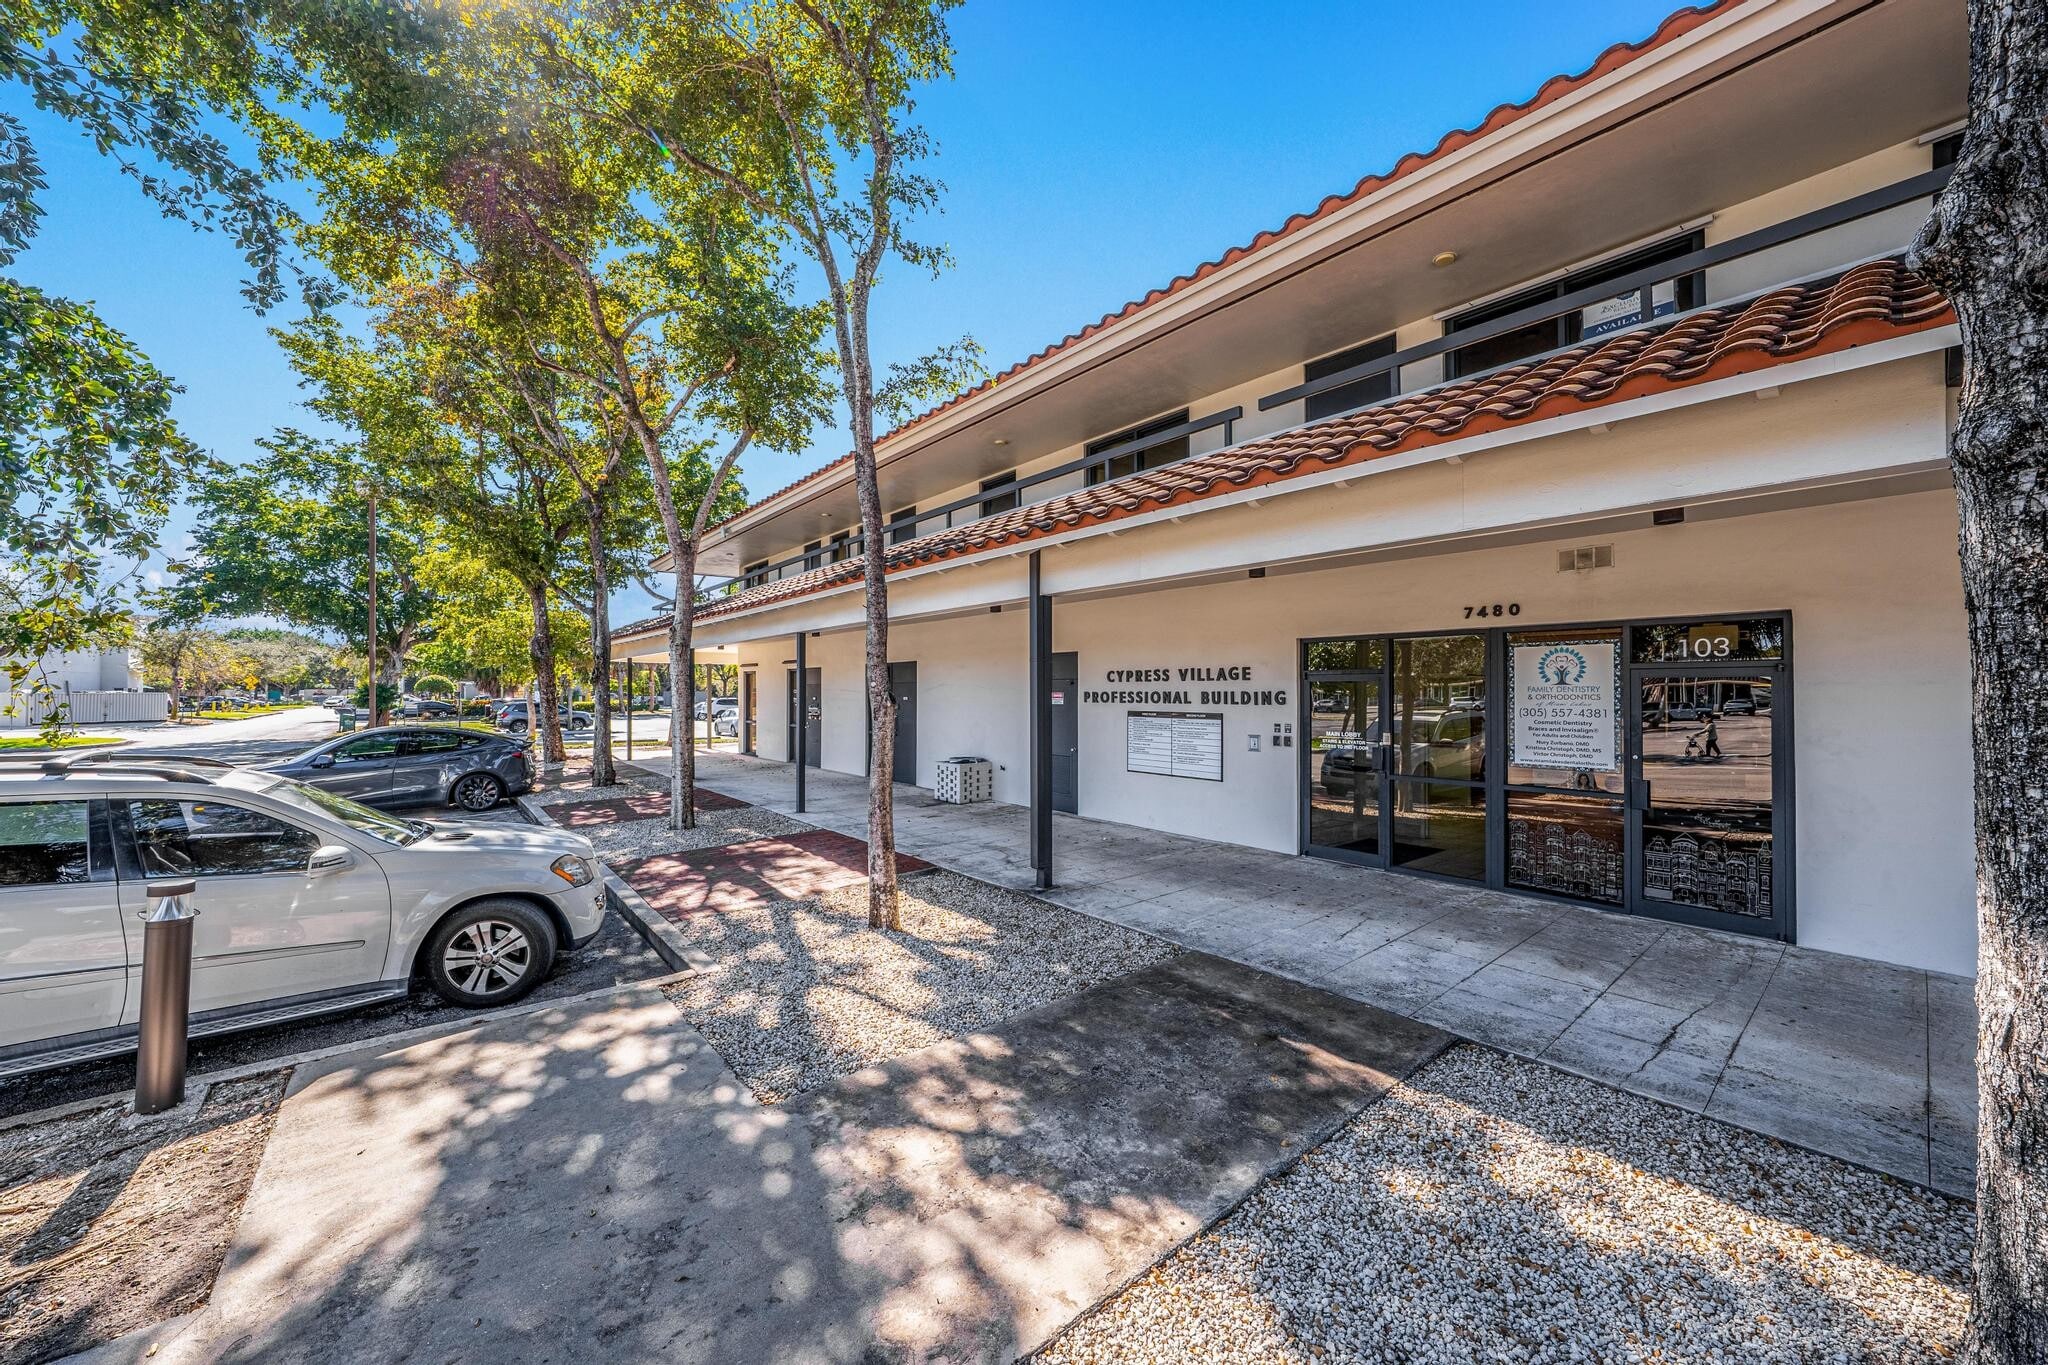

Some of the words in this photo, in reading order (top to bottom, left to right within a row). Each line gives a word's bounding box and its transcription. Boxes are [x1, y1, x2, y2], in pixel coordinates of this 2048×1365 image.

[1596, 308, 1662, 333] AVAILAE
[1464, 604, 1520, 619] 7480
[1679, 637, 1730, 657] 103
[1107, 668, 1170, 682] CYPRESS
[1178, 666, 1251, 682] VILLAGE
[1083, 690, 1192, 704] PROFESSIONAL
[1200, 690, 1287, 706] BUILDING
[1535, 693, 1601, 701] ORTHODONTICS
[1519, 707, 1547, 718] (305)
[1551, 709, 1608, 718] 557-4381
